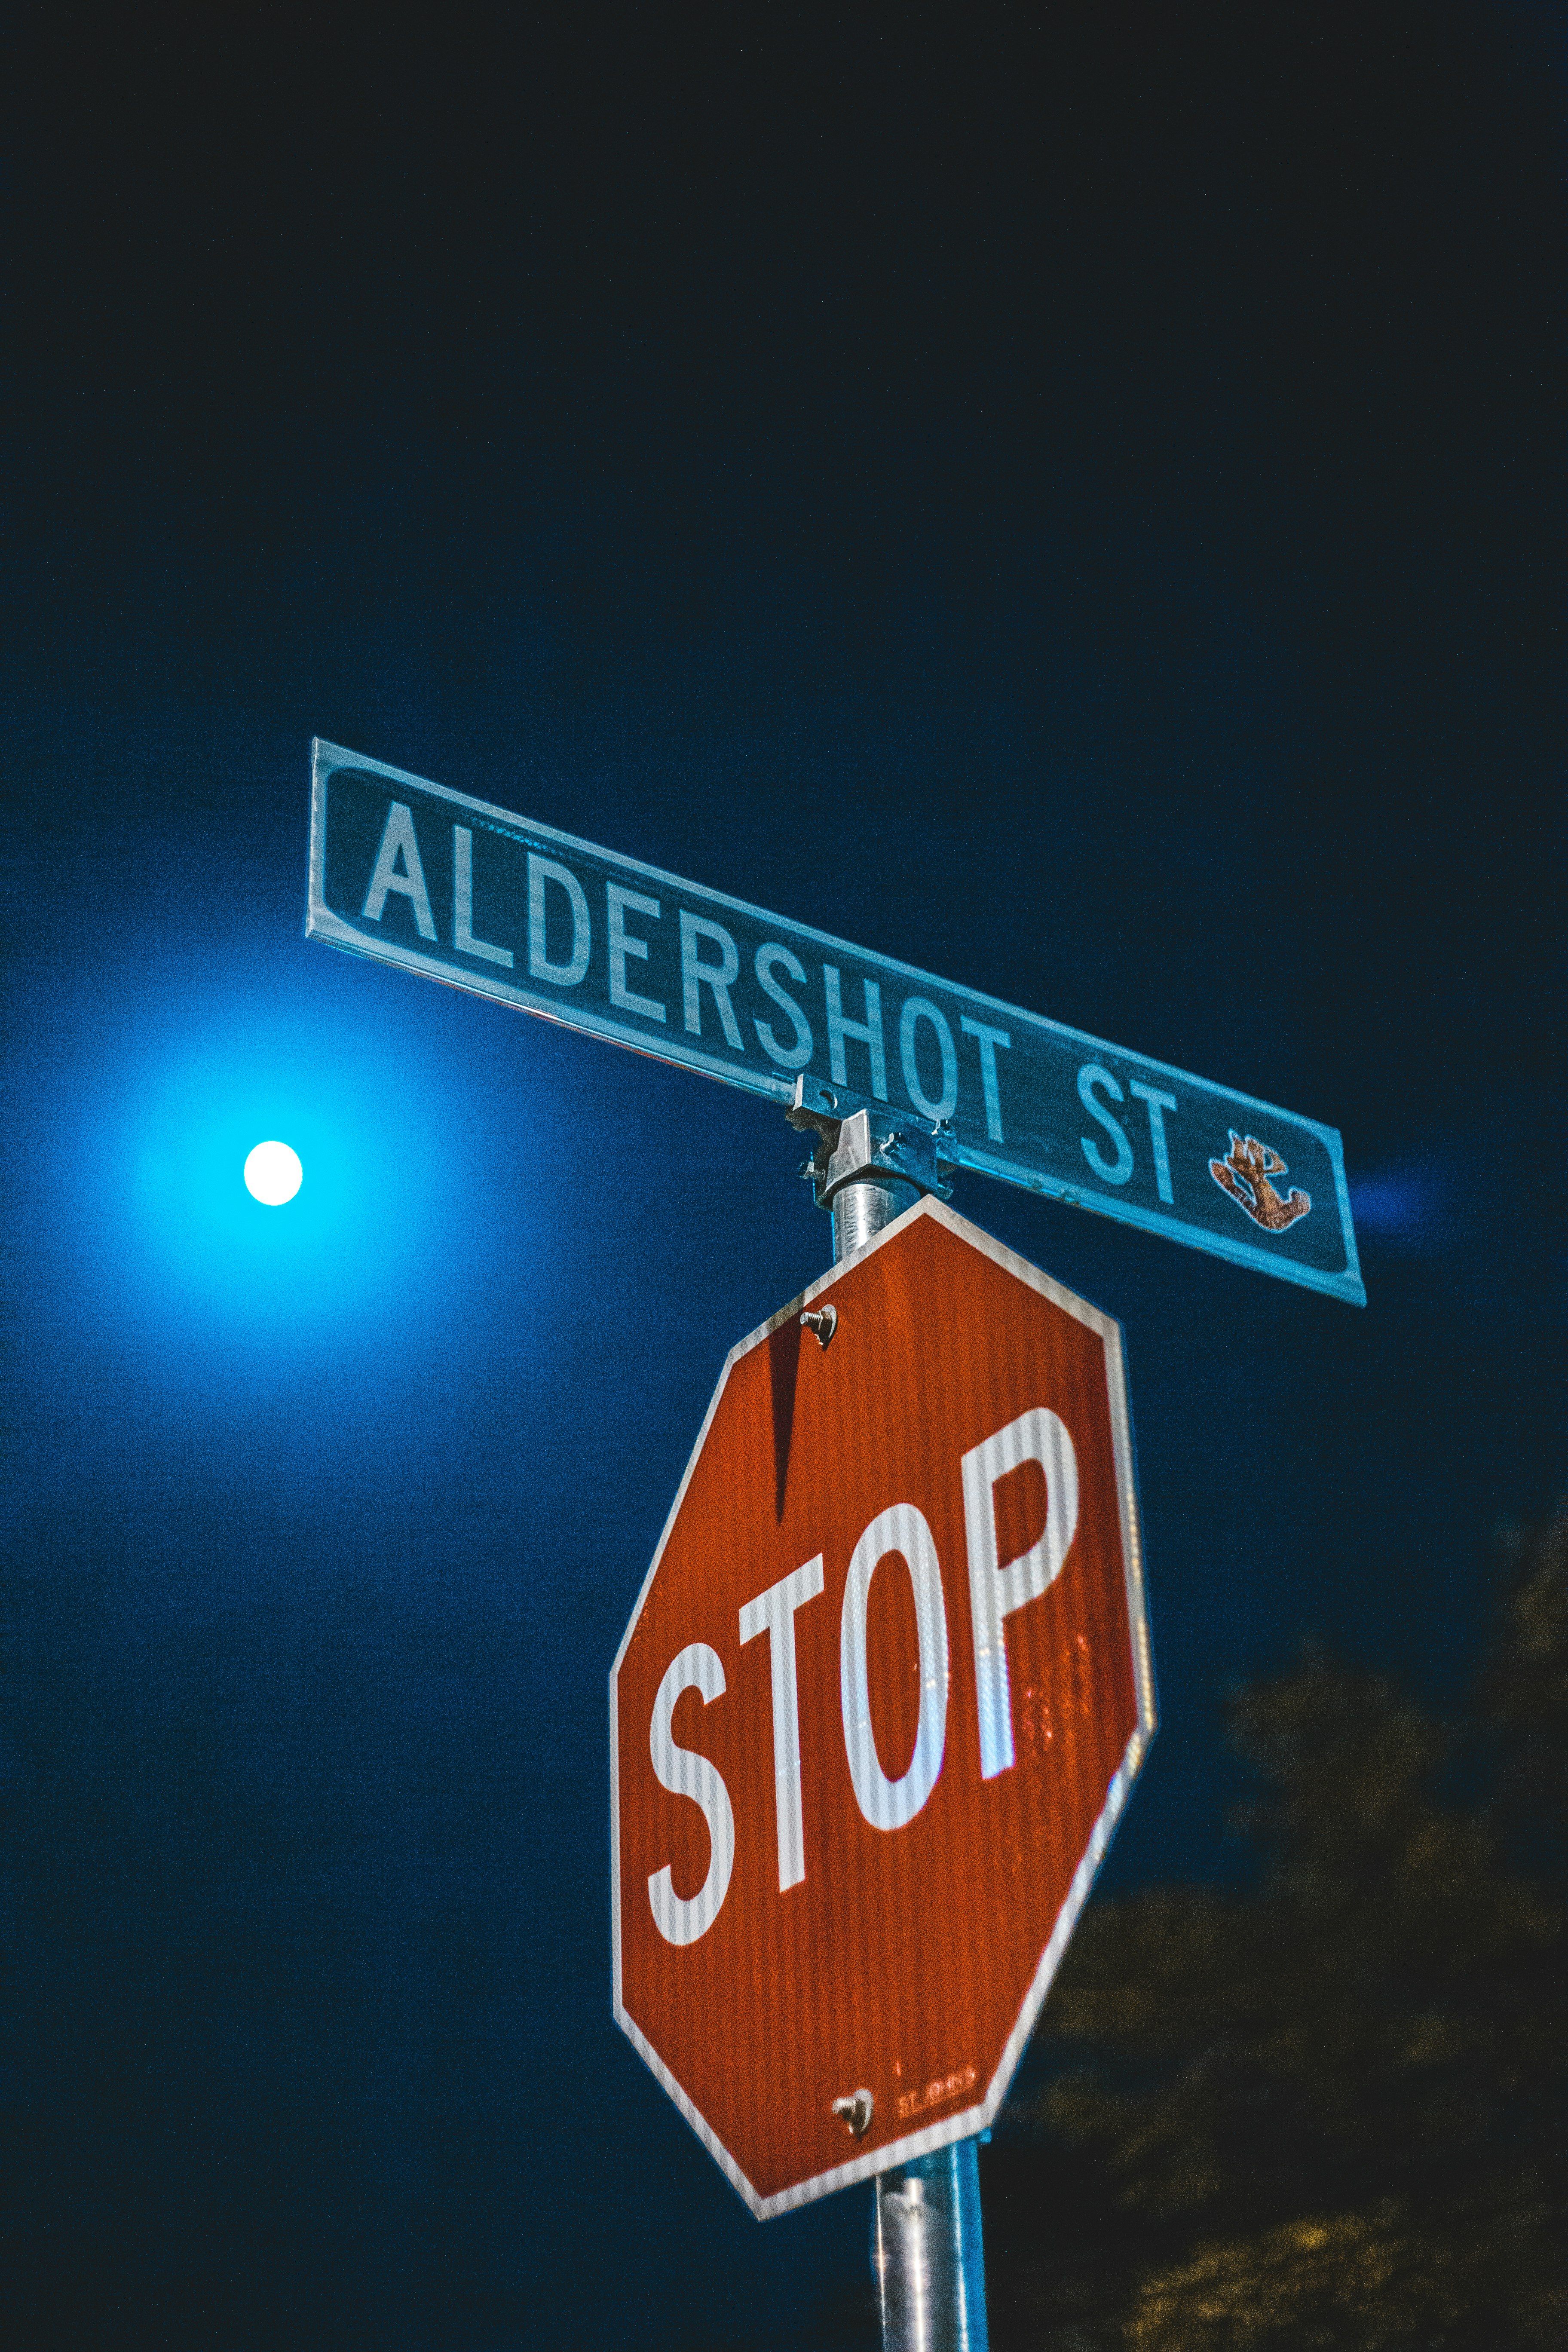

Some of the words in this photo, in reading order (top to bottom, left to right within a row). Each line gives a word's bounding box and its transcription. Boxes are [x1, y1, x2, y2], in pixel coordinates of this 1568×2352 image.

[362, 801, 1011, 1143] ALDERSHOT
[1076, 1063, 1178, 1204] ST
[648, 1407, 1079, 1945] STOP
